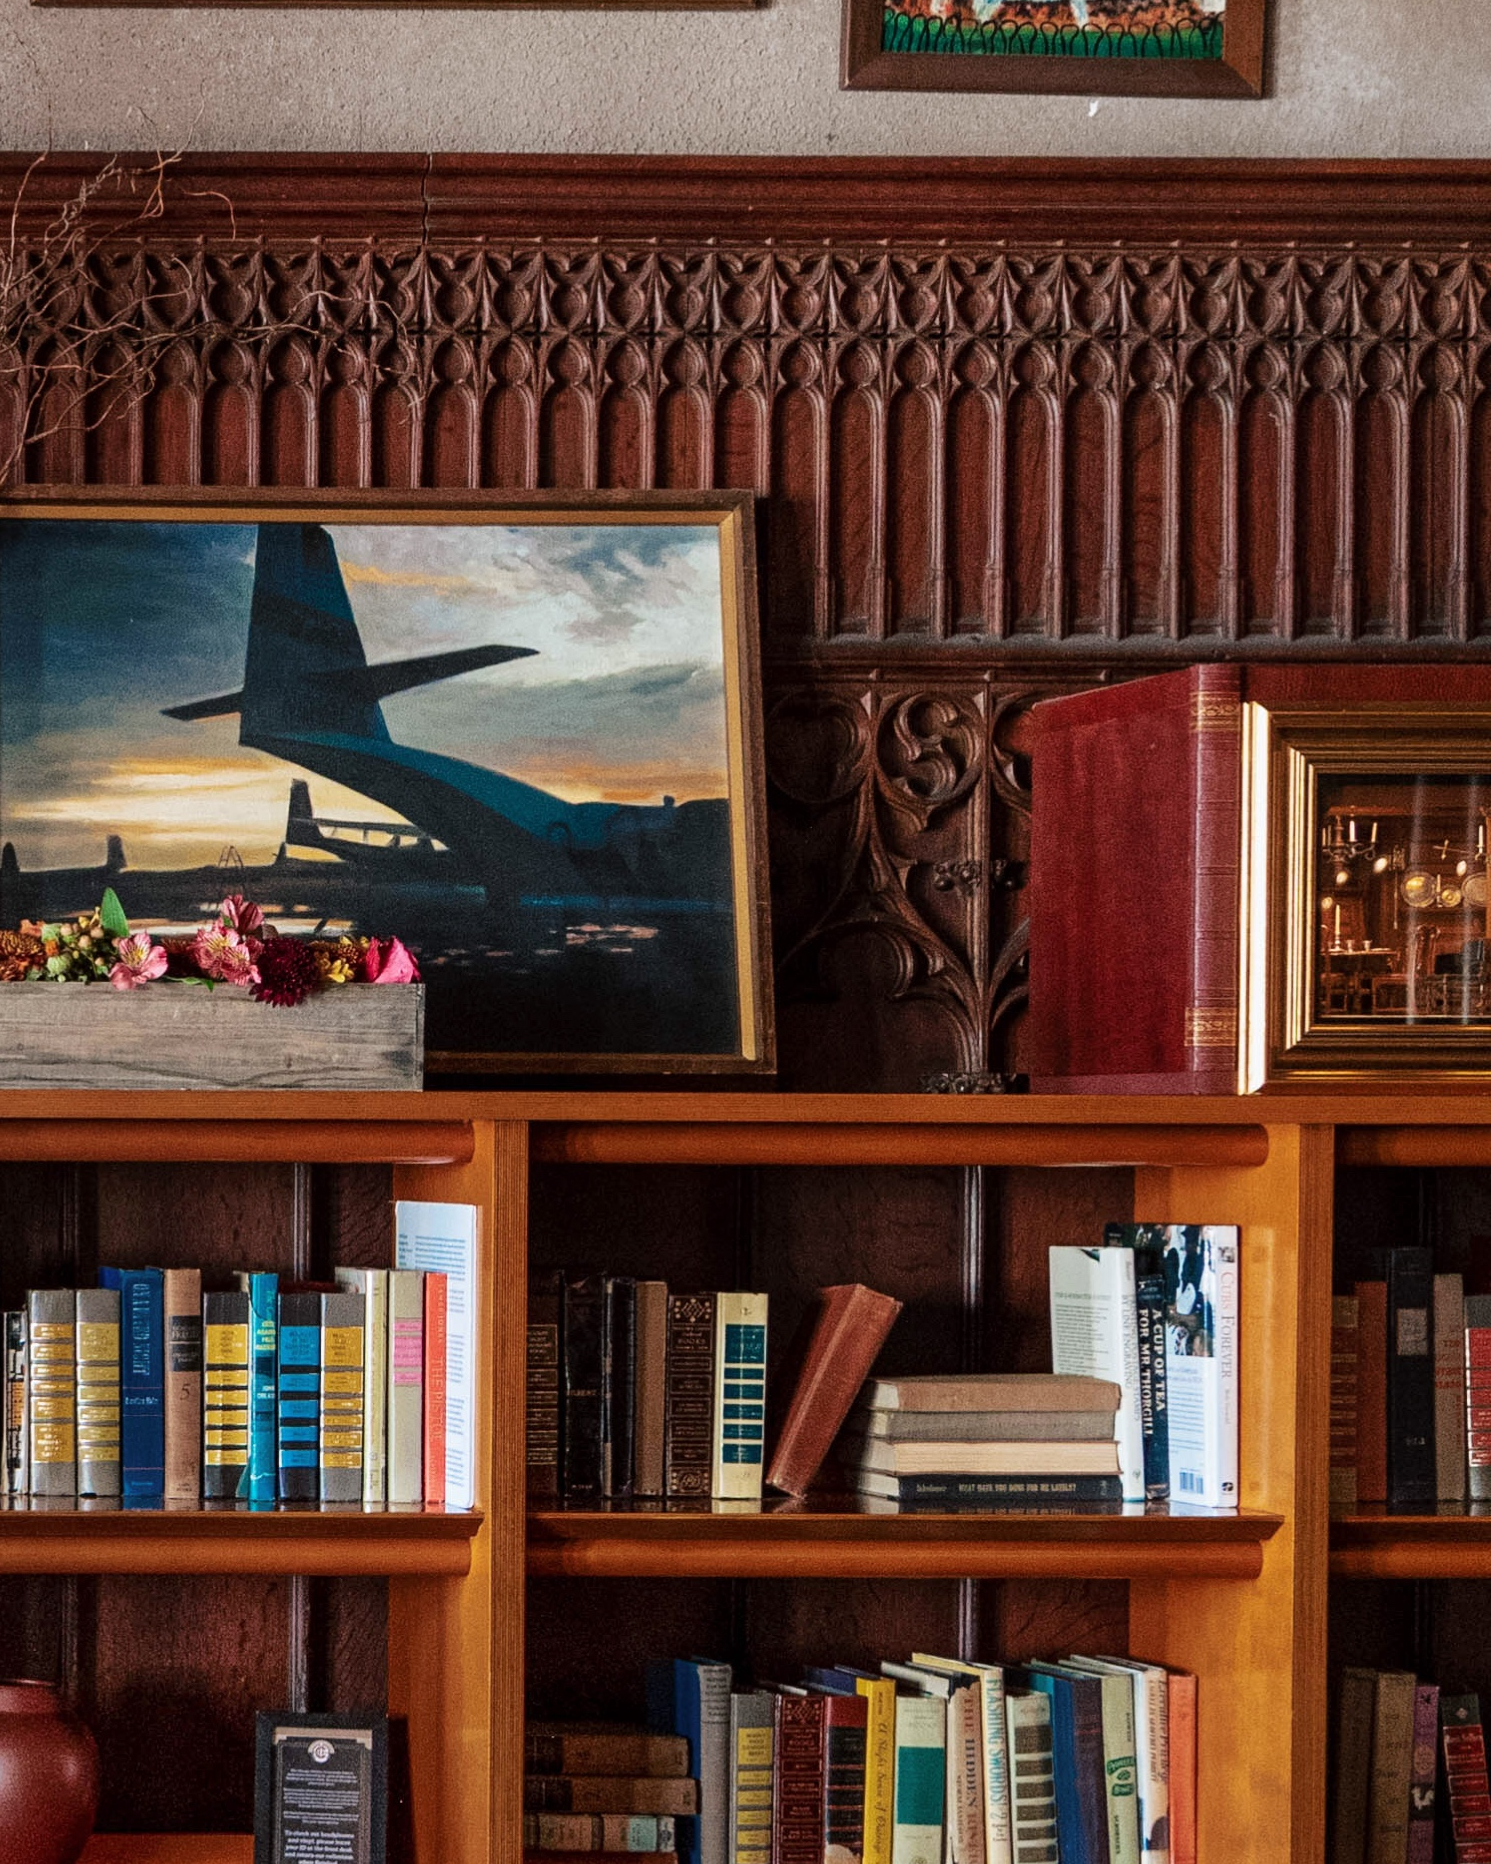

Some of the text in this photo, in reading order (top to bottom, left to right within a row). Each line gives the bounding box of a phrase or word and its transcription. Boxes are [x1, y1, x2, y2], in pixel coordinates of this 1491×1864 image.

[1122, 1309, 1131, 1331] LINE
[1138, 1309, 1151, 1337] FOR
[1220, 1271, 1235, 1379] CUBS FOREVER
[431, 1357, 443, 1387] THE
[1123, 1333, 1133, 1389] ENGRAVING
[1152, 1309, 1167, 1411] A CUP OF TEA
[430, 1392, 443, 1441] PISTOL
[1140, 1369, 1154, 1437] THORGILL
[986, 1679, 1005, 1744] FLASHING
[964, 1698, 979, 1864] THE HIDDEN RIVER
[988, 1749, 1007, 1807] SWORDS!
[874, 1802, 887, 1812] of
